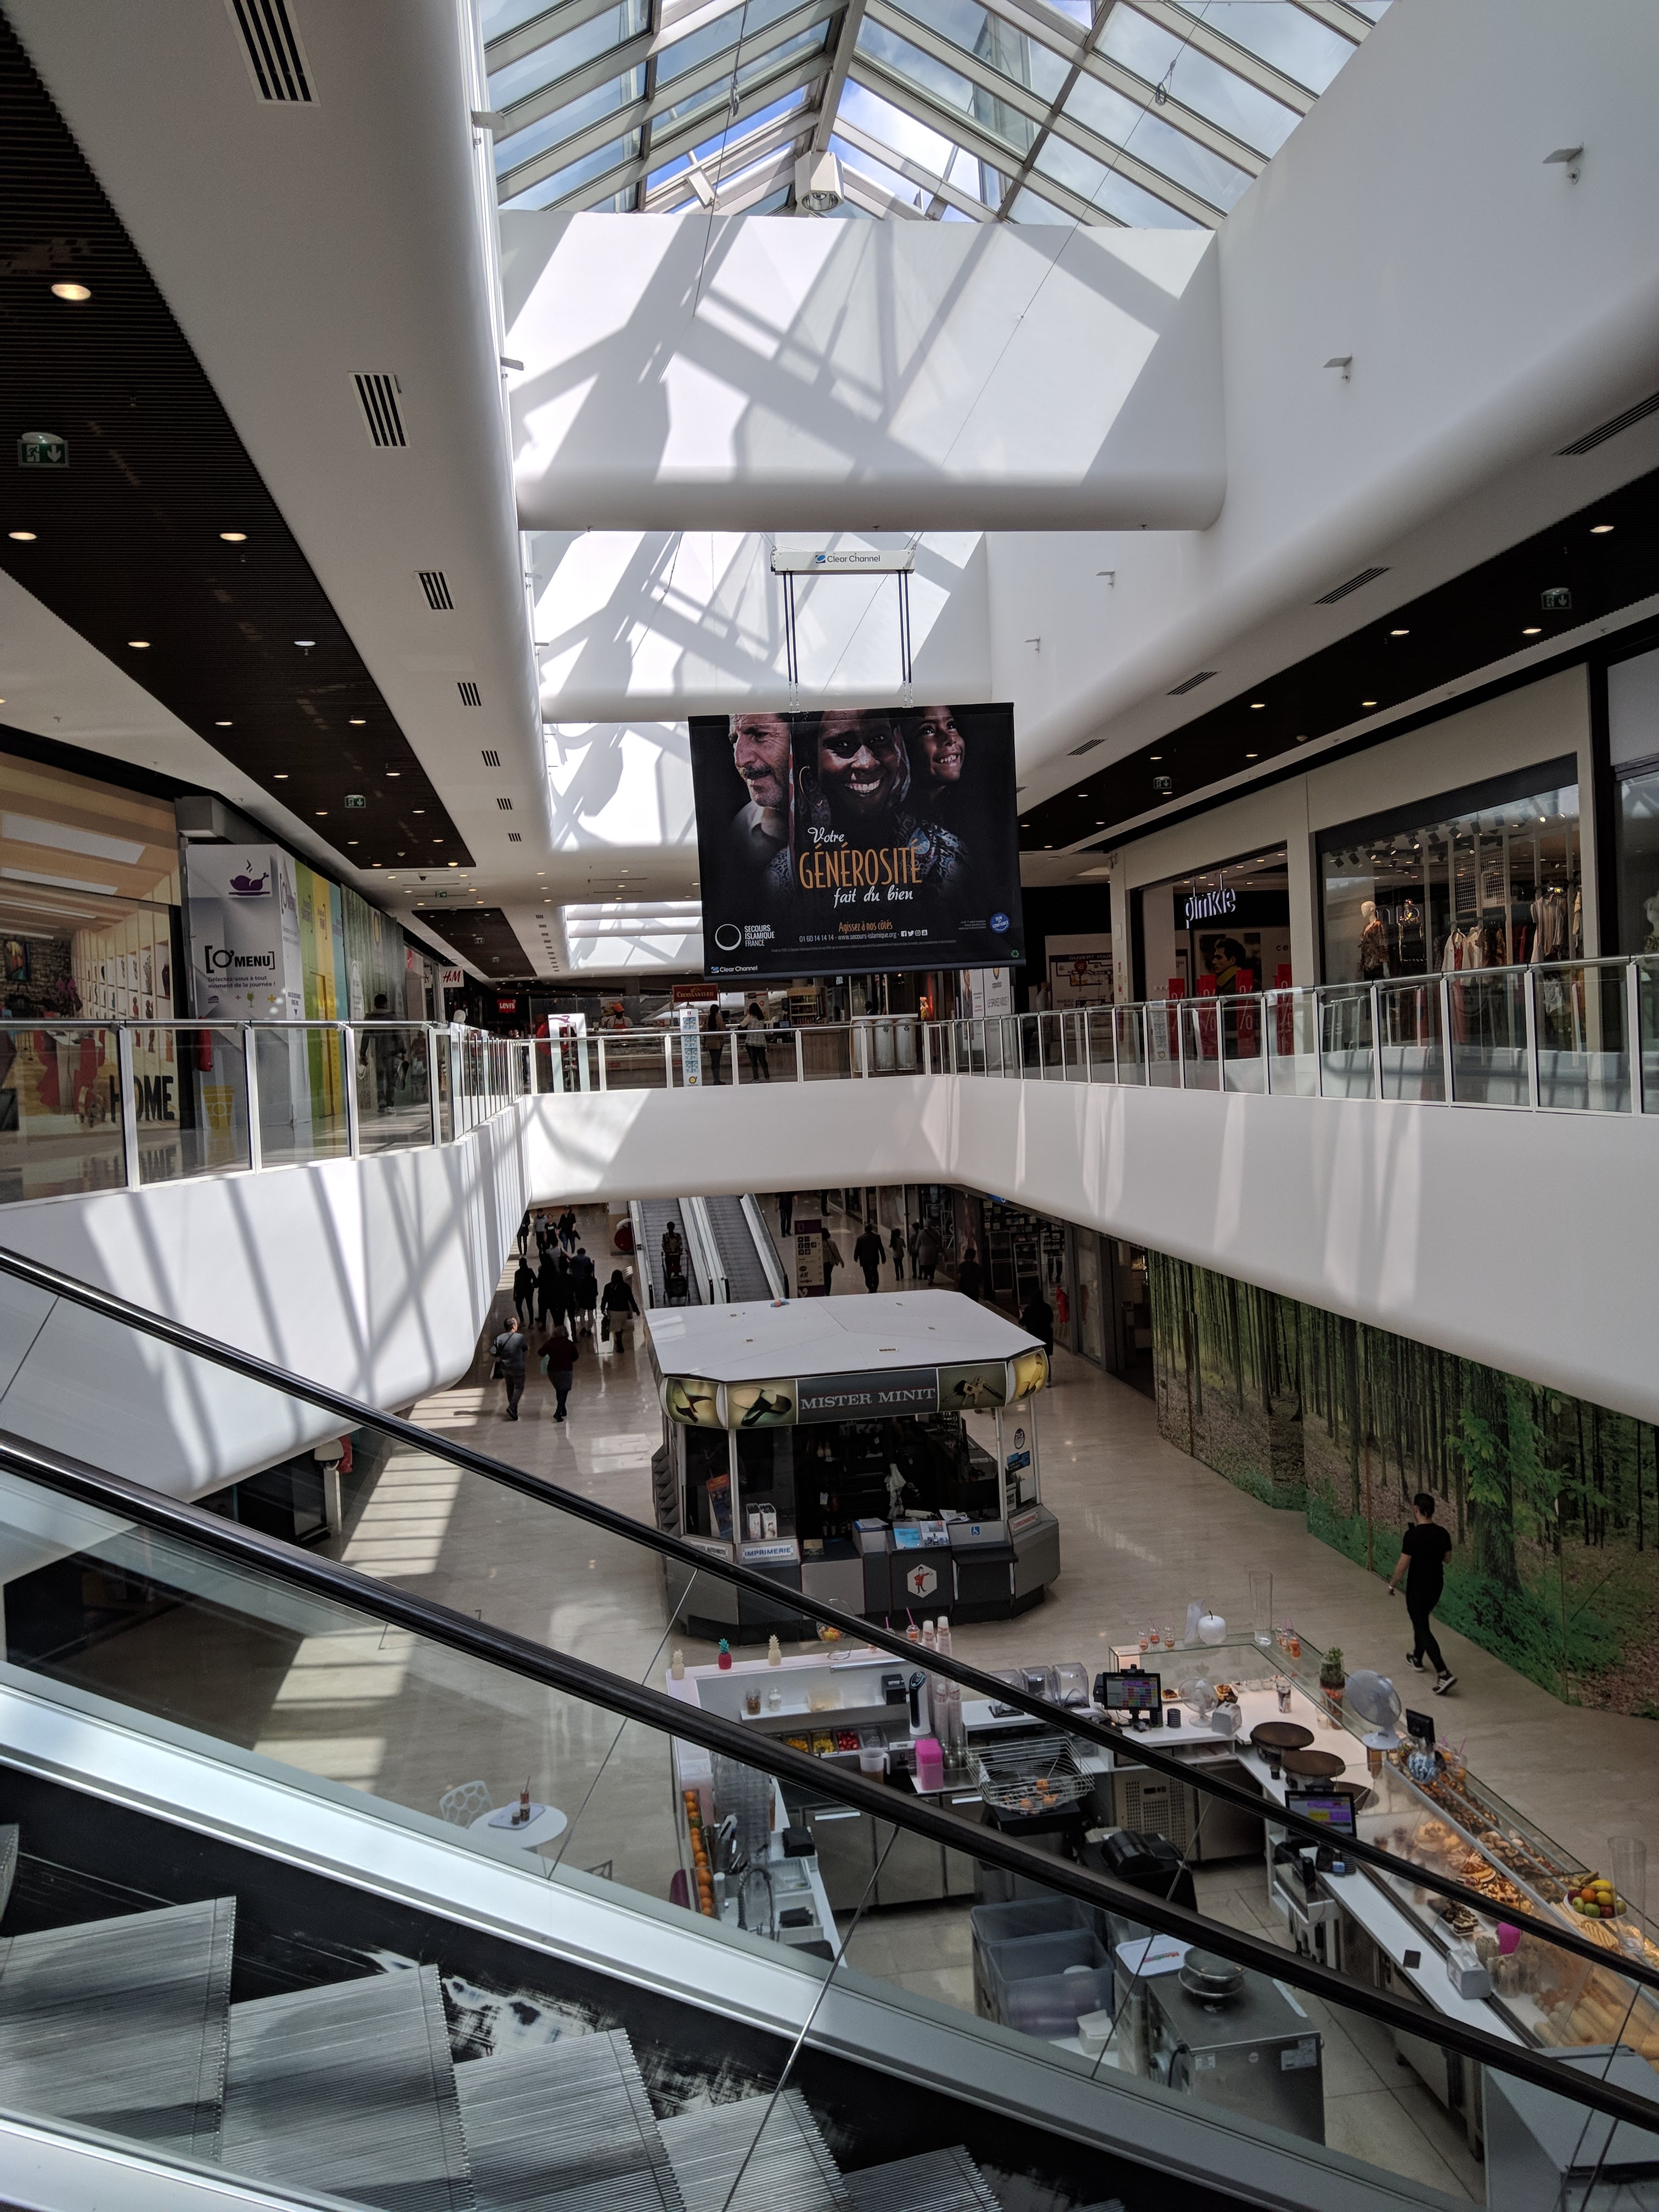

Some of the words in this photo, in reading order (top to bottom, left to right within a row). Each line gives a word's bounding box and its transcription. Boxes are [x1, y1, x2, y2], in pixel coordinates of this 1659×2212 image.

[807, 827, 845, 844] Votre
[799, 838, 922, 889] GÉNÉROSITÉ
[833, 887, 856, 909] fait
[863, 885, 881, 903] du
[887, 884, 913, 901] bien
[744, 924, 771, 933] SECOURS
[838, 922, 860, 934] Agissez
[861, 921, 866, 931] à
[866, 922, 877, 931] nos
[878, 919, 893, 930] côtés
[744, 931, 775, 940] ISLAMIQUE
[745, 939, 765, 947] FRANCE
[800, 1393, 872, 1410] MISTER
[878, 1388, 935, 1403] MINIT
[744, 1547, 792, 1557] IMPRIMERIE
